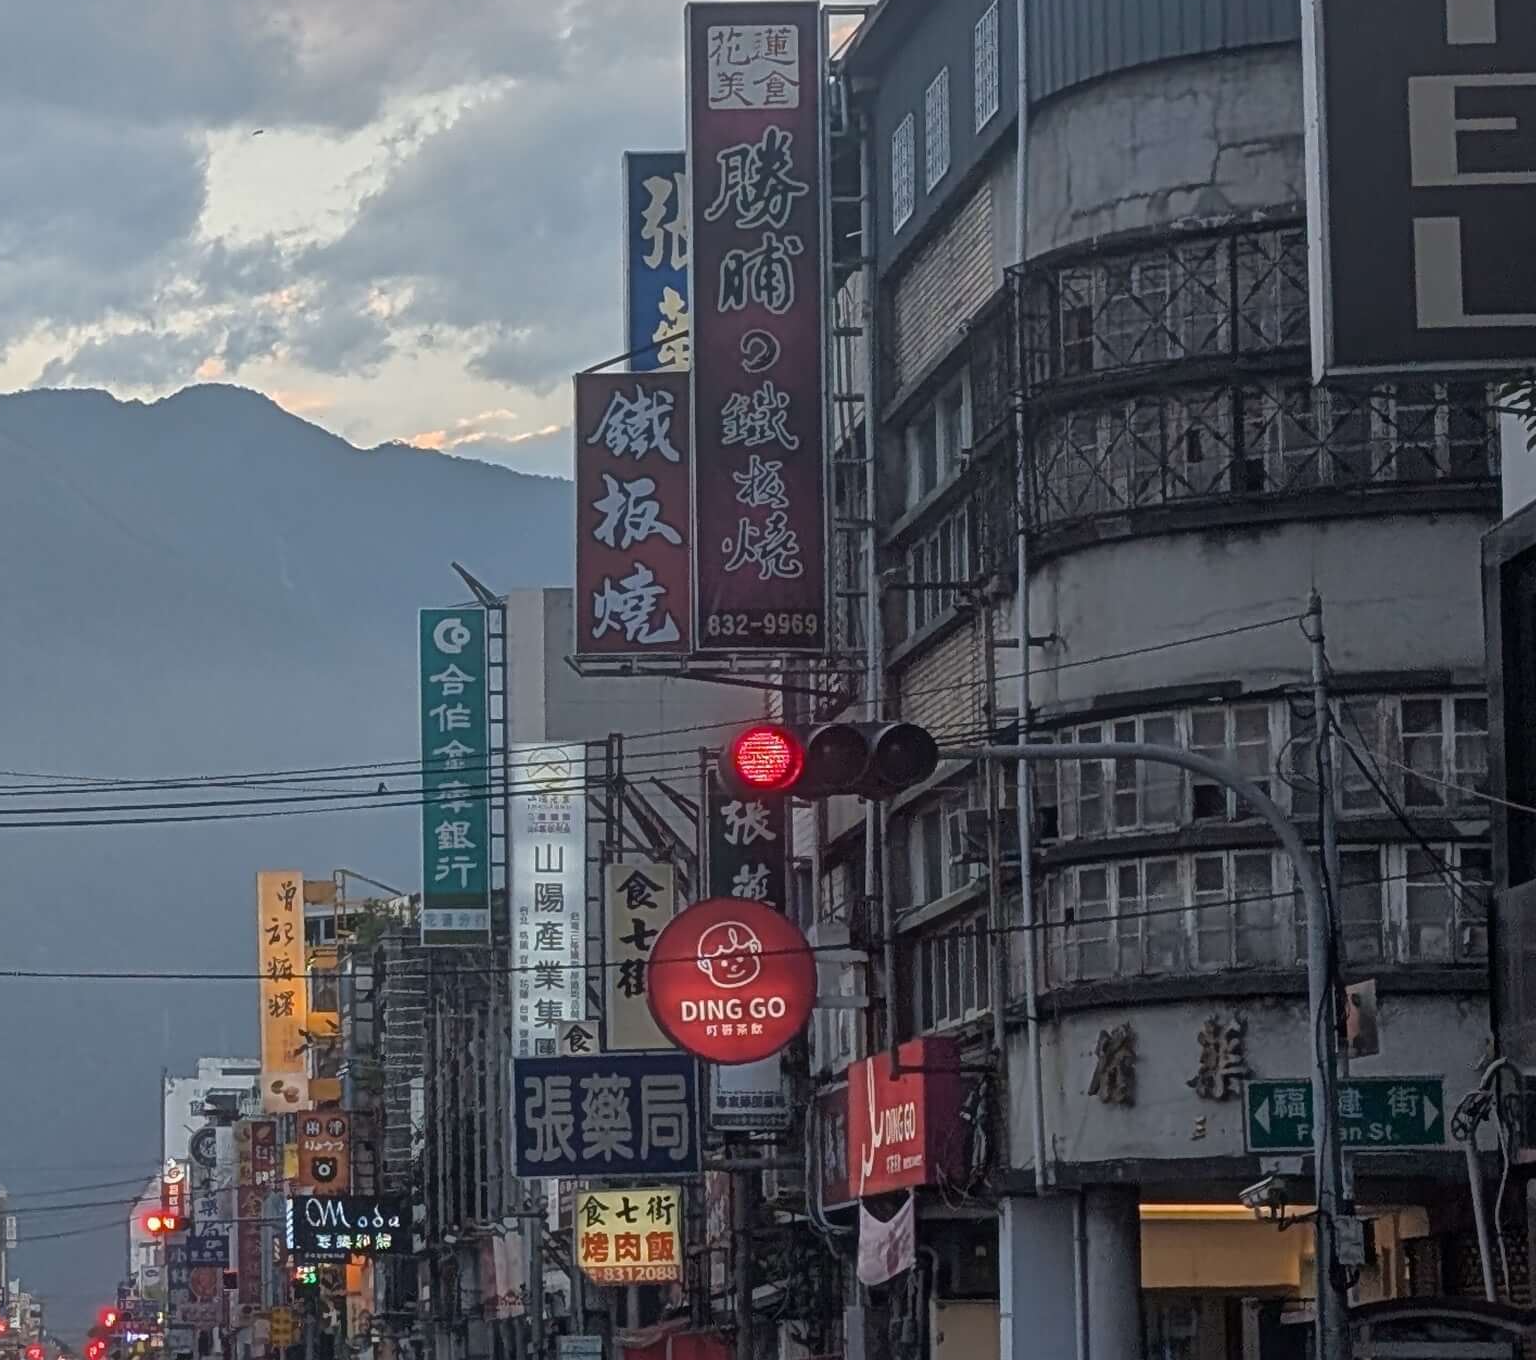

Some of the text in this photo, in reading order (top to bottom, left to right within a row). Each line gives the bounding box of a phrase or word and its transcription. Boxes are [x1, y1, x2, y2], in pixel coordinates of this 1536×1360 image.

[709, 27, 797, 66] 花蓮
[710, 70, 800, 106] 美食
[586, 384, 681, 646] 鐵板燒
[707, 613, 818, 637] 832-9969
[429, 663, 477, 889] 合作金庫銀行
[534, 843, 565, 1056] 山陽產業集團
[681, 997, 786, 1022] DING GO
[563, 1024, 594, 1052] 食
[524, 1072, 690, 1163] 張藥局
[1273, 1086, 1418, 1120] 福建街
[885, 1101, 915, 1144] DING GO
[305, 1198, 400, 1228] Moda
[579, 1195, 675, 1228] 食七街
[581, 1231, 674, 1262] 烤肉飯
[604, 1266, 678, 1282] 8312088
